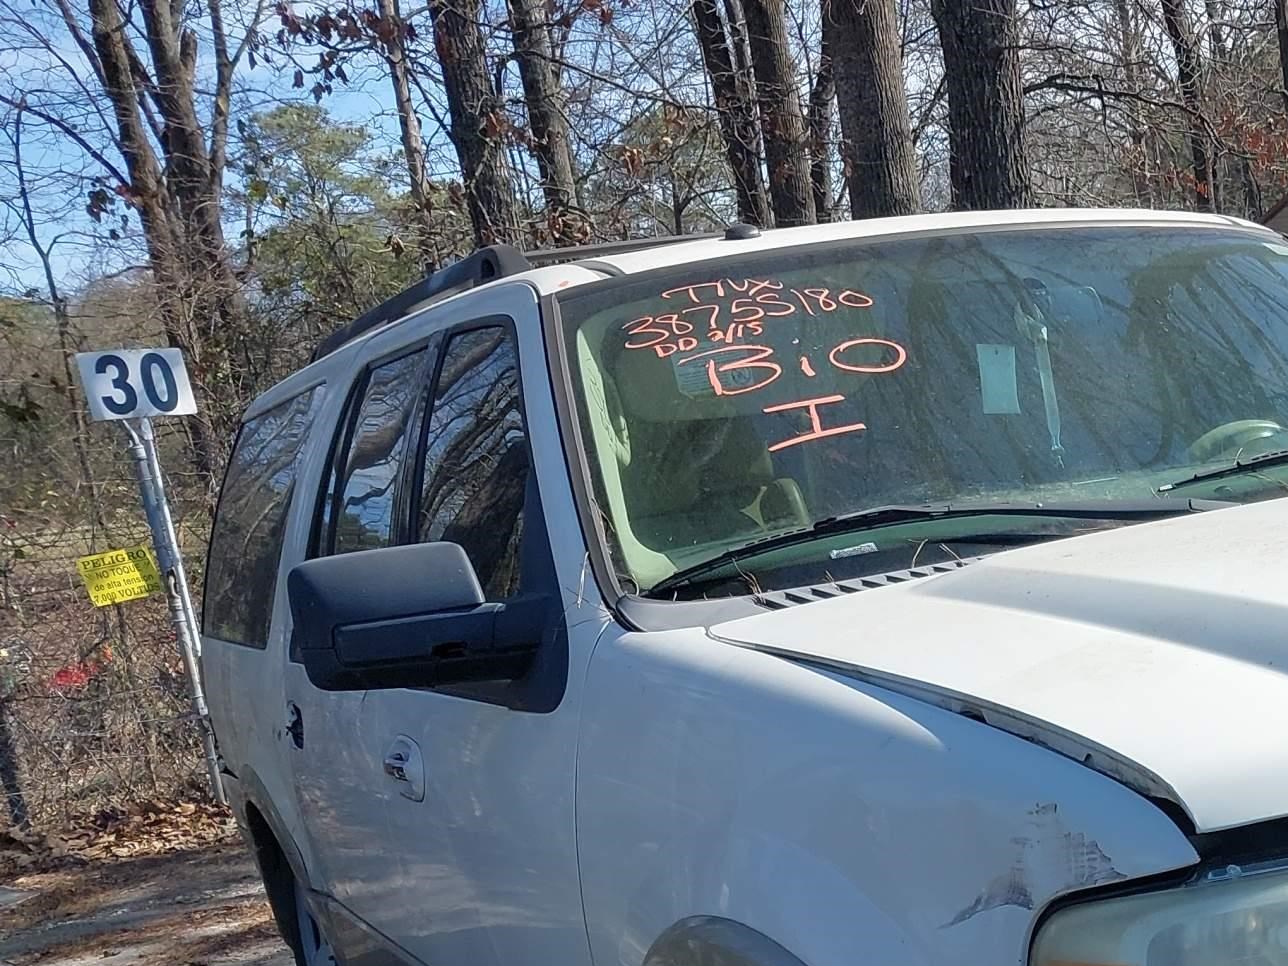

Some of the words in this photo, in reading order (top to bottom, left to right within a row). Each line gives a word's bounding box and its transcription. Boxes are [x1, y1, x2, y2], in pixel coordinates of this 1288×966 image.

[621, 287, 873, 349] 38755180
[95, 352, 179, 415] 30
[80, 549, 146, 569] PELIGRO
[106, 580, 122, 591] alta
